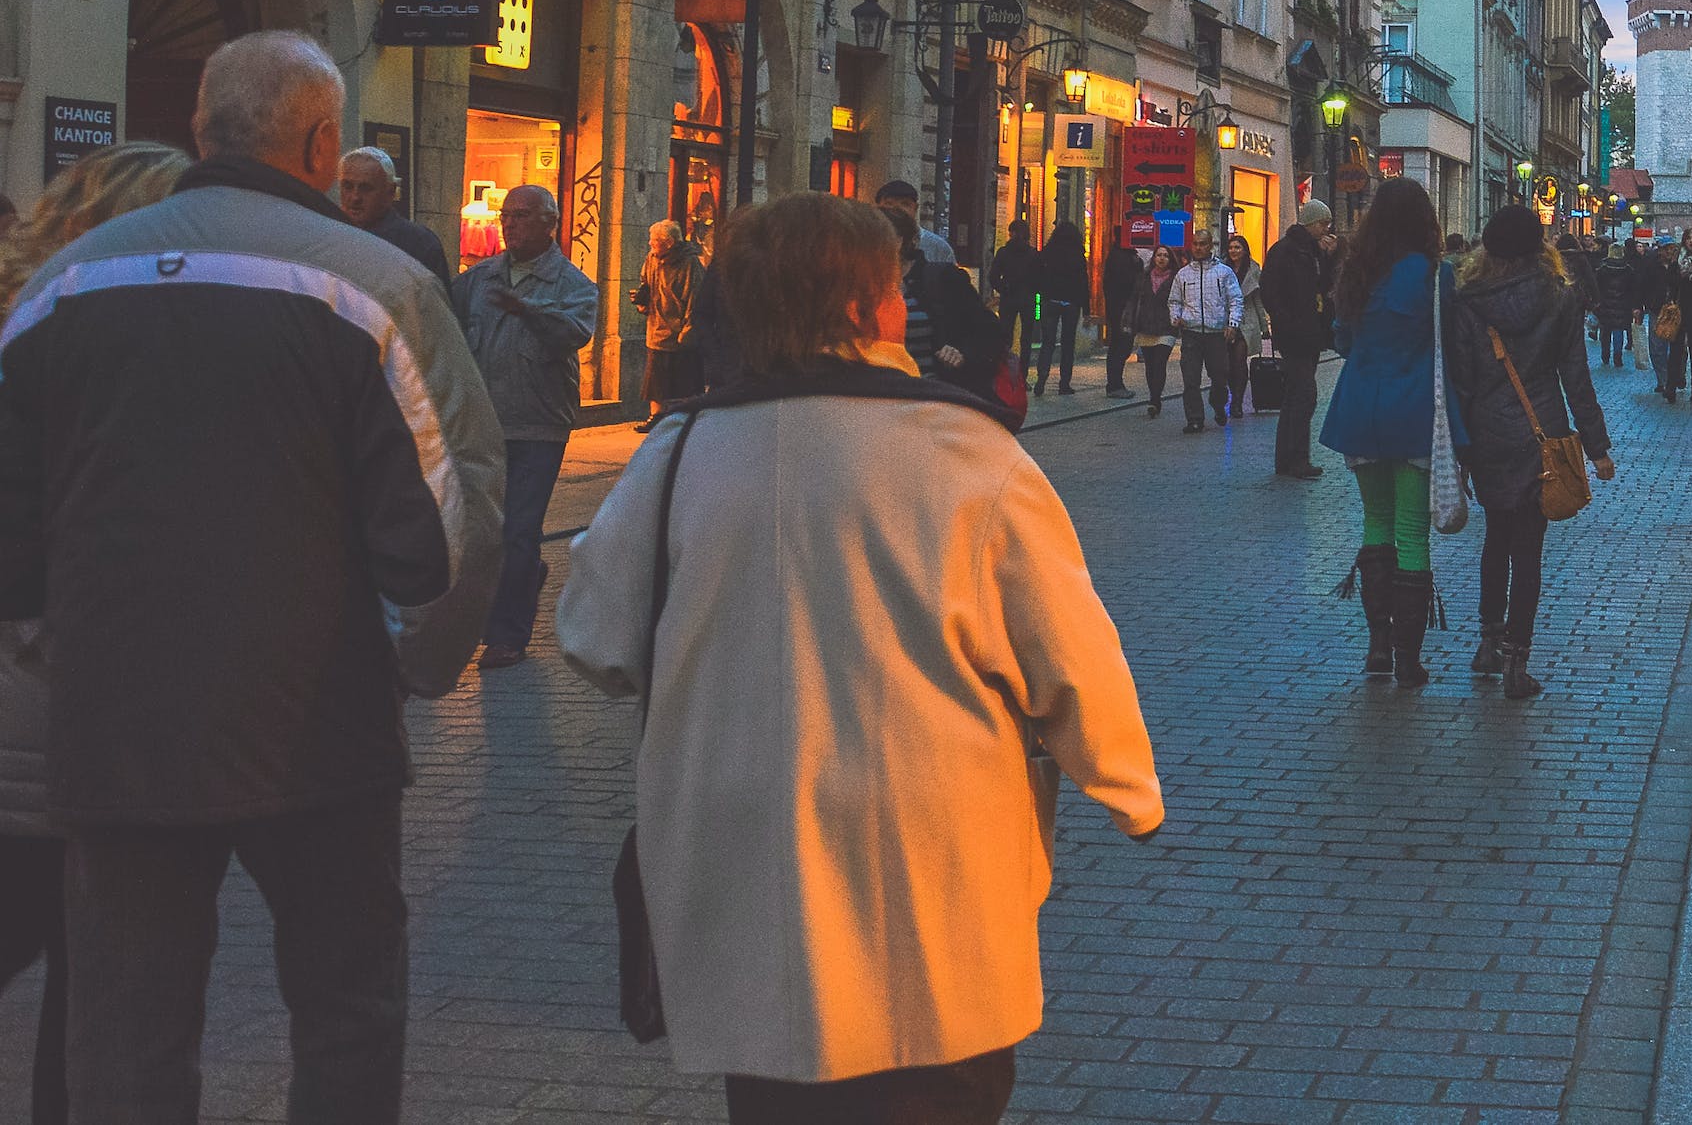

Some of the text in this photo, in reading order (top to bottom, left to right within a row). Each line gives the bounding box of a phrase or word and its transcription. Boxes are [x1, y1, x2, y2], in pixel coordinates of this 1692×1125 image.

[983, 5, 1022, 24] Tattoo
[54, 106, 112, 124] CHANGE
[54, 127, 112, 145] KANTOR
[1131, 141, 1188, 155] t-shirts
